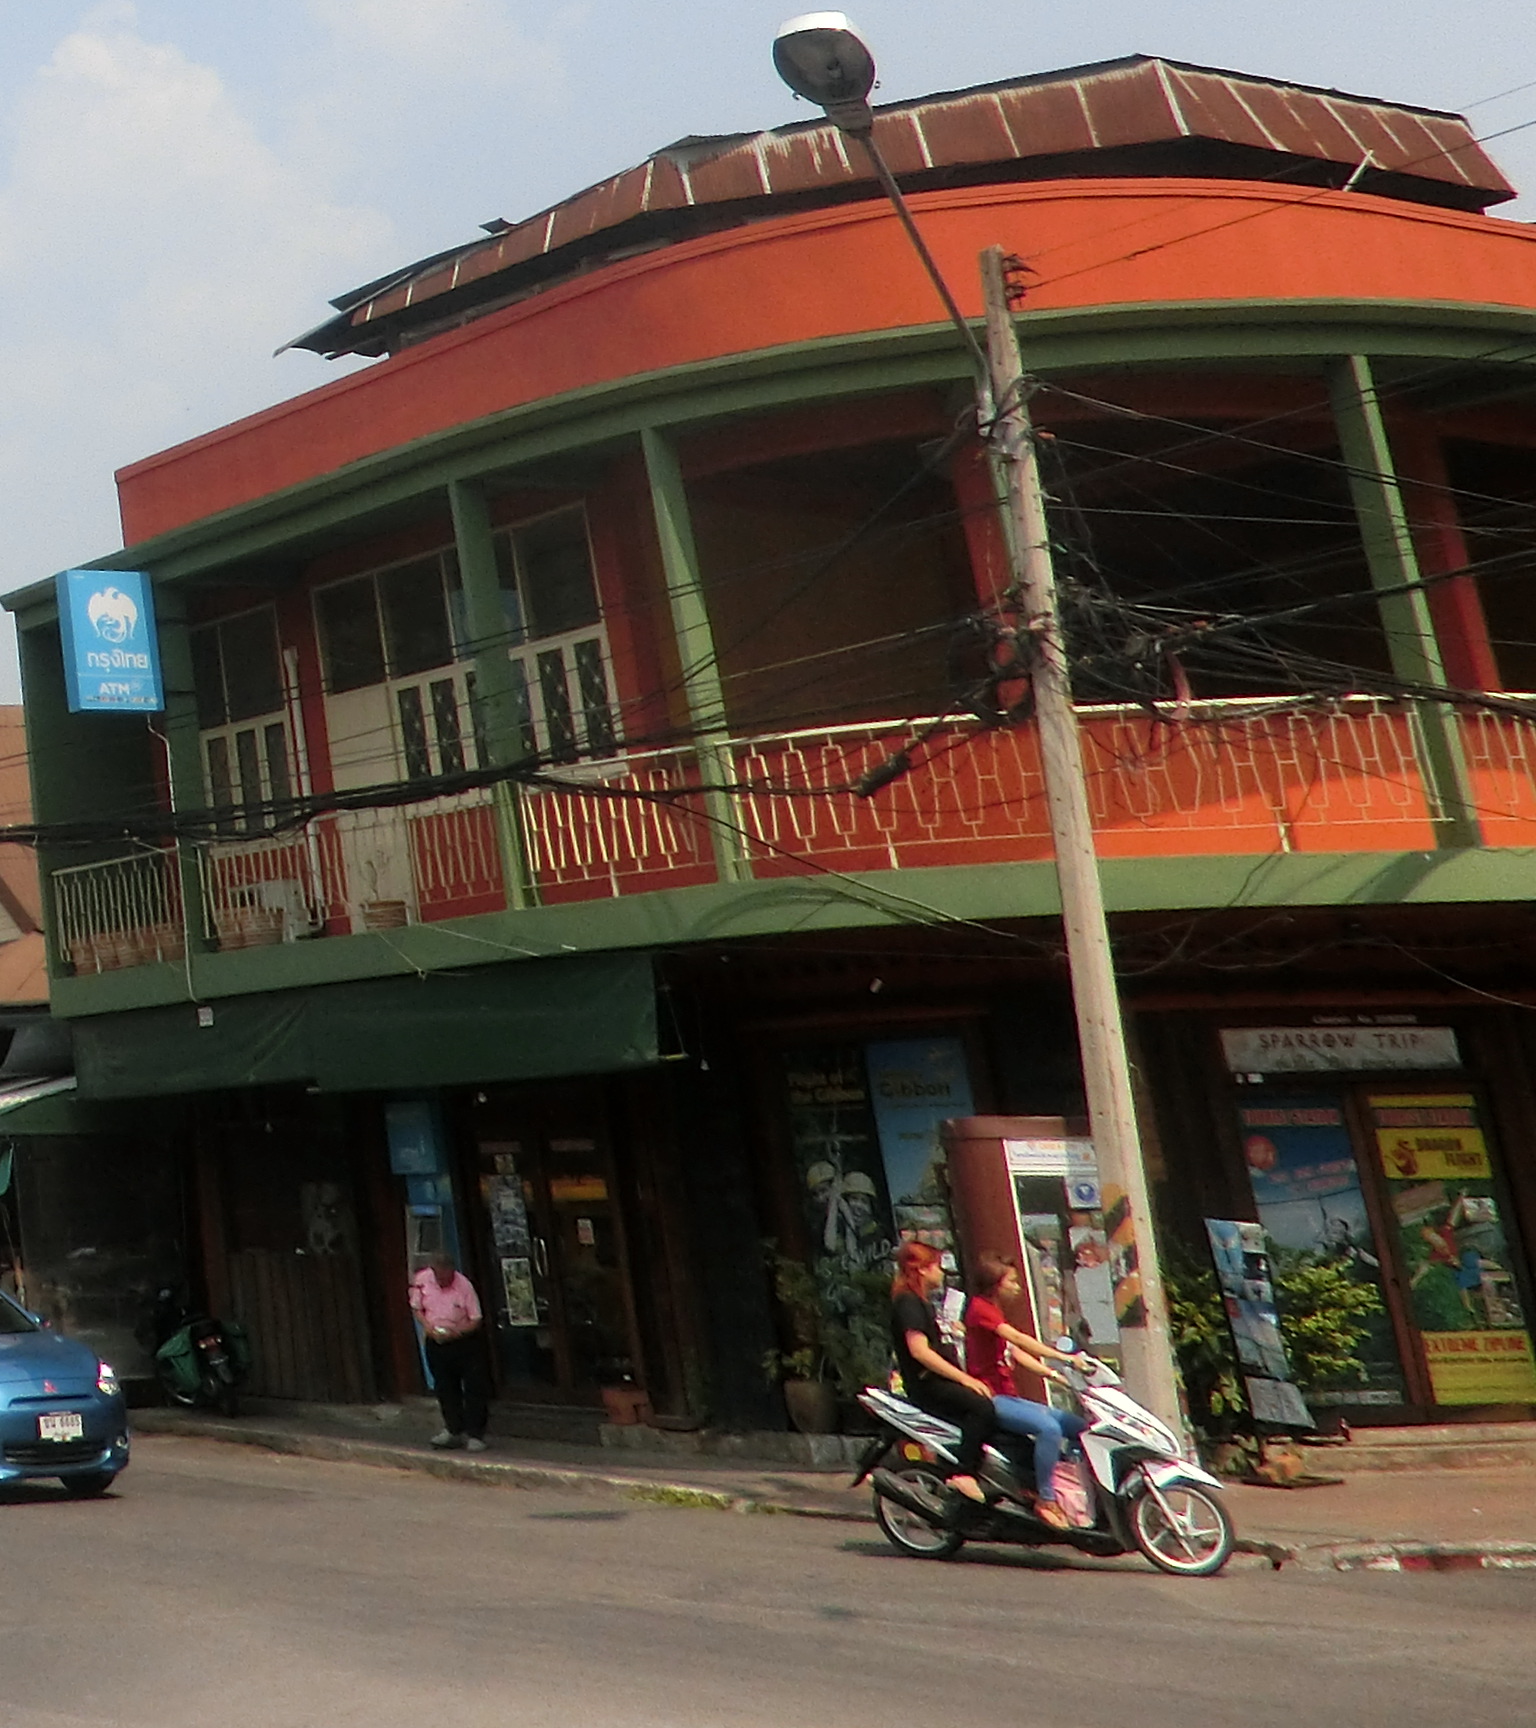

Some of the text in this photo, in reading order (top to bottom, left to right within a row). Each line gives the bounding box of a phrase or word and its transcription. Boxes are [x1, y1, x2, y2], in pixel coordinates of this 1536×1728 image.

[87, 649, 149, 673] กรุงไทย
[99, 682, 131, 696] ATM
[1259, 1033, 1419, 1049] SPARROW TRIP
